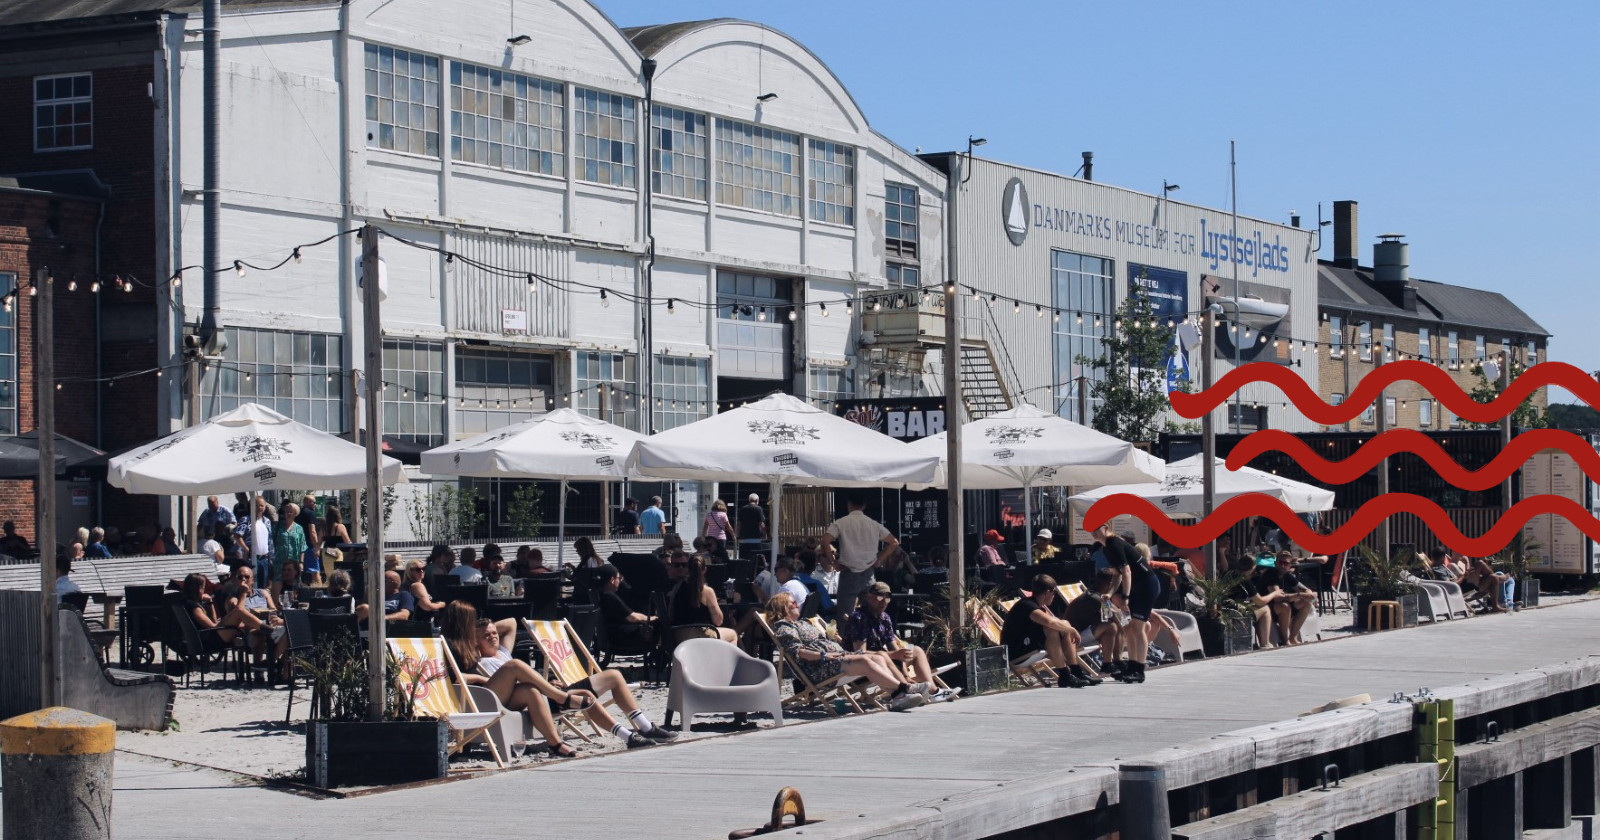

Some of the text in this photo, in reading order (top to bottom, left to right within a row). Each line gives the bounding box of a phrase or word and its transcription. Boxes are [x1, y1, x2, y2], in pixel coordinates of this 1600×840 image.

[1033, 203, 1289, 277] DANMARKS MUSEUM FOR Lystsejlads
[865, 293, 918, 310] SRVIAL
[887, 410, 945, 438] BAR
